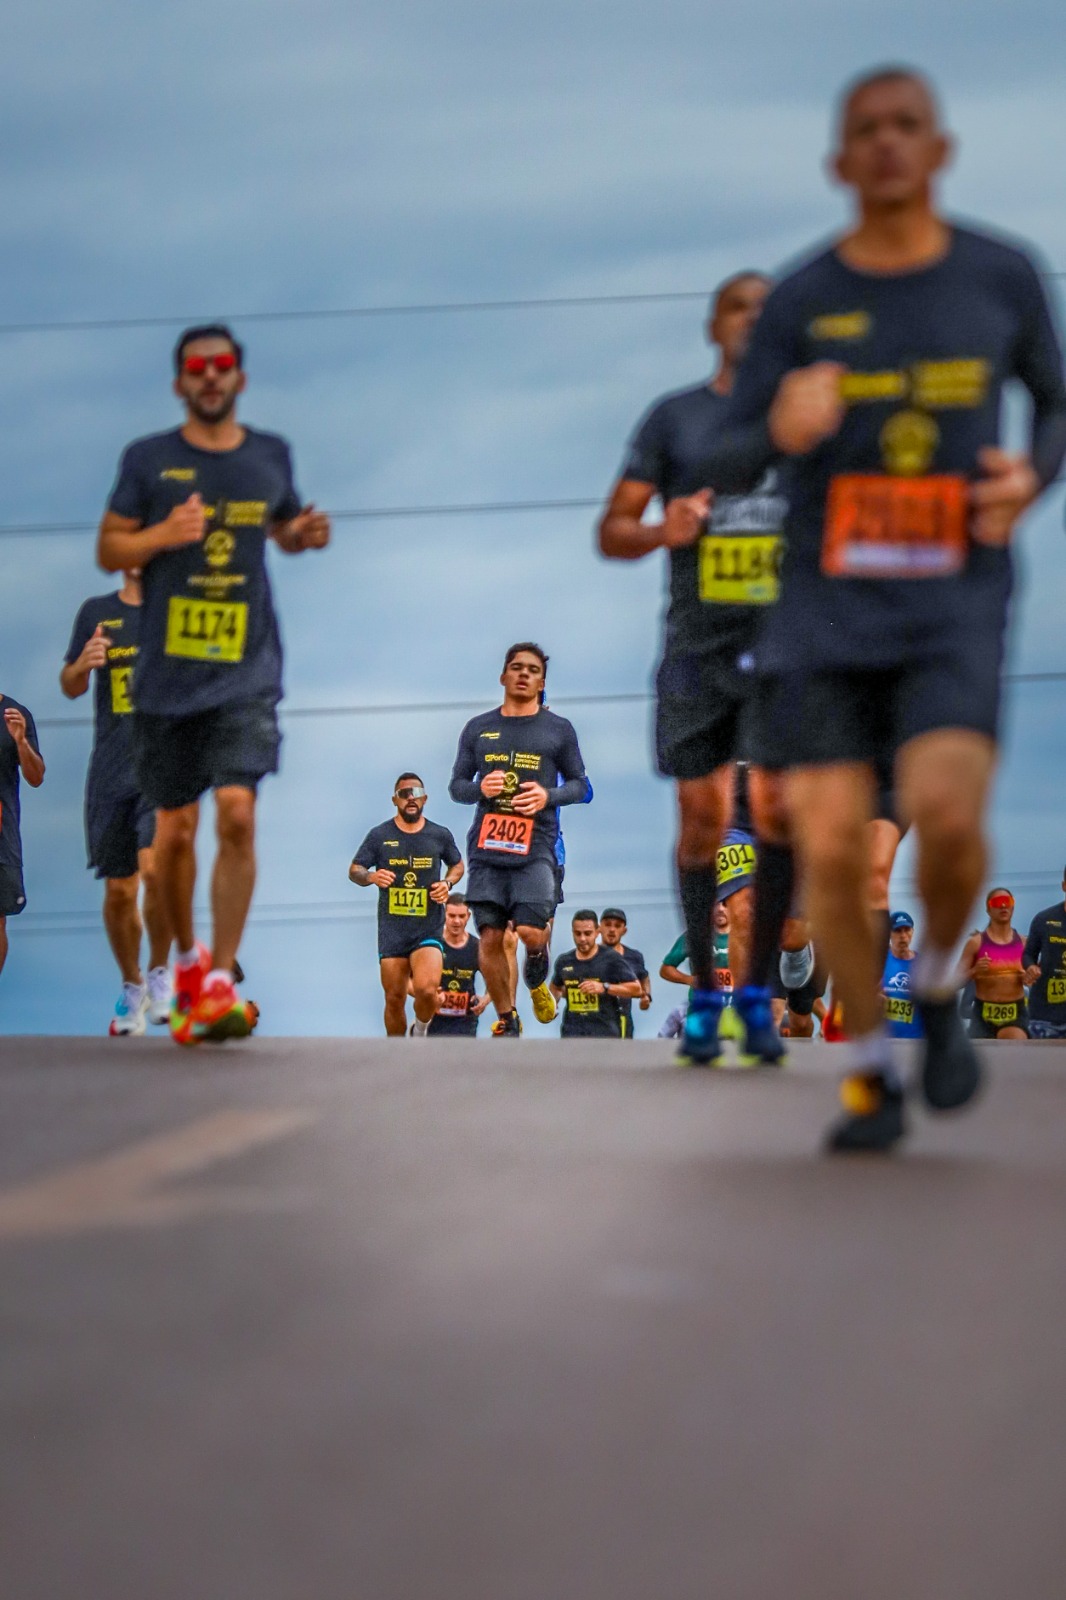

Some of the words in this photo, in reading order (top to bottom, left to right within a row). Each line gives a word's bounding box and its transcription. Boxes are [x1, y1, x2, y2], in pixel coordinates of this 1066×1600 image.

[179, 606, 236, 641] 1174
[486, 818, 527, 843] 2402
[394, 891, 424, 908] 1171
[886, 1000, 913, 1017] 1233
[987, 1006, 1014, 1020] 1269
